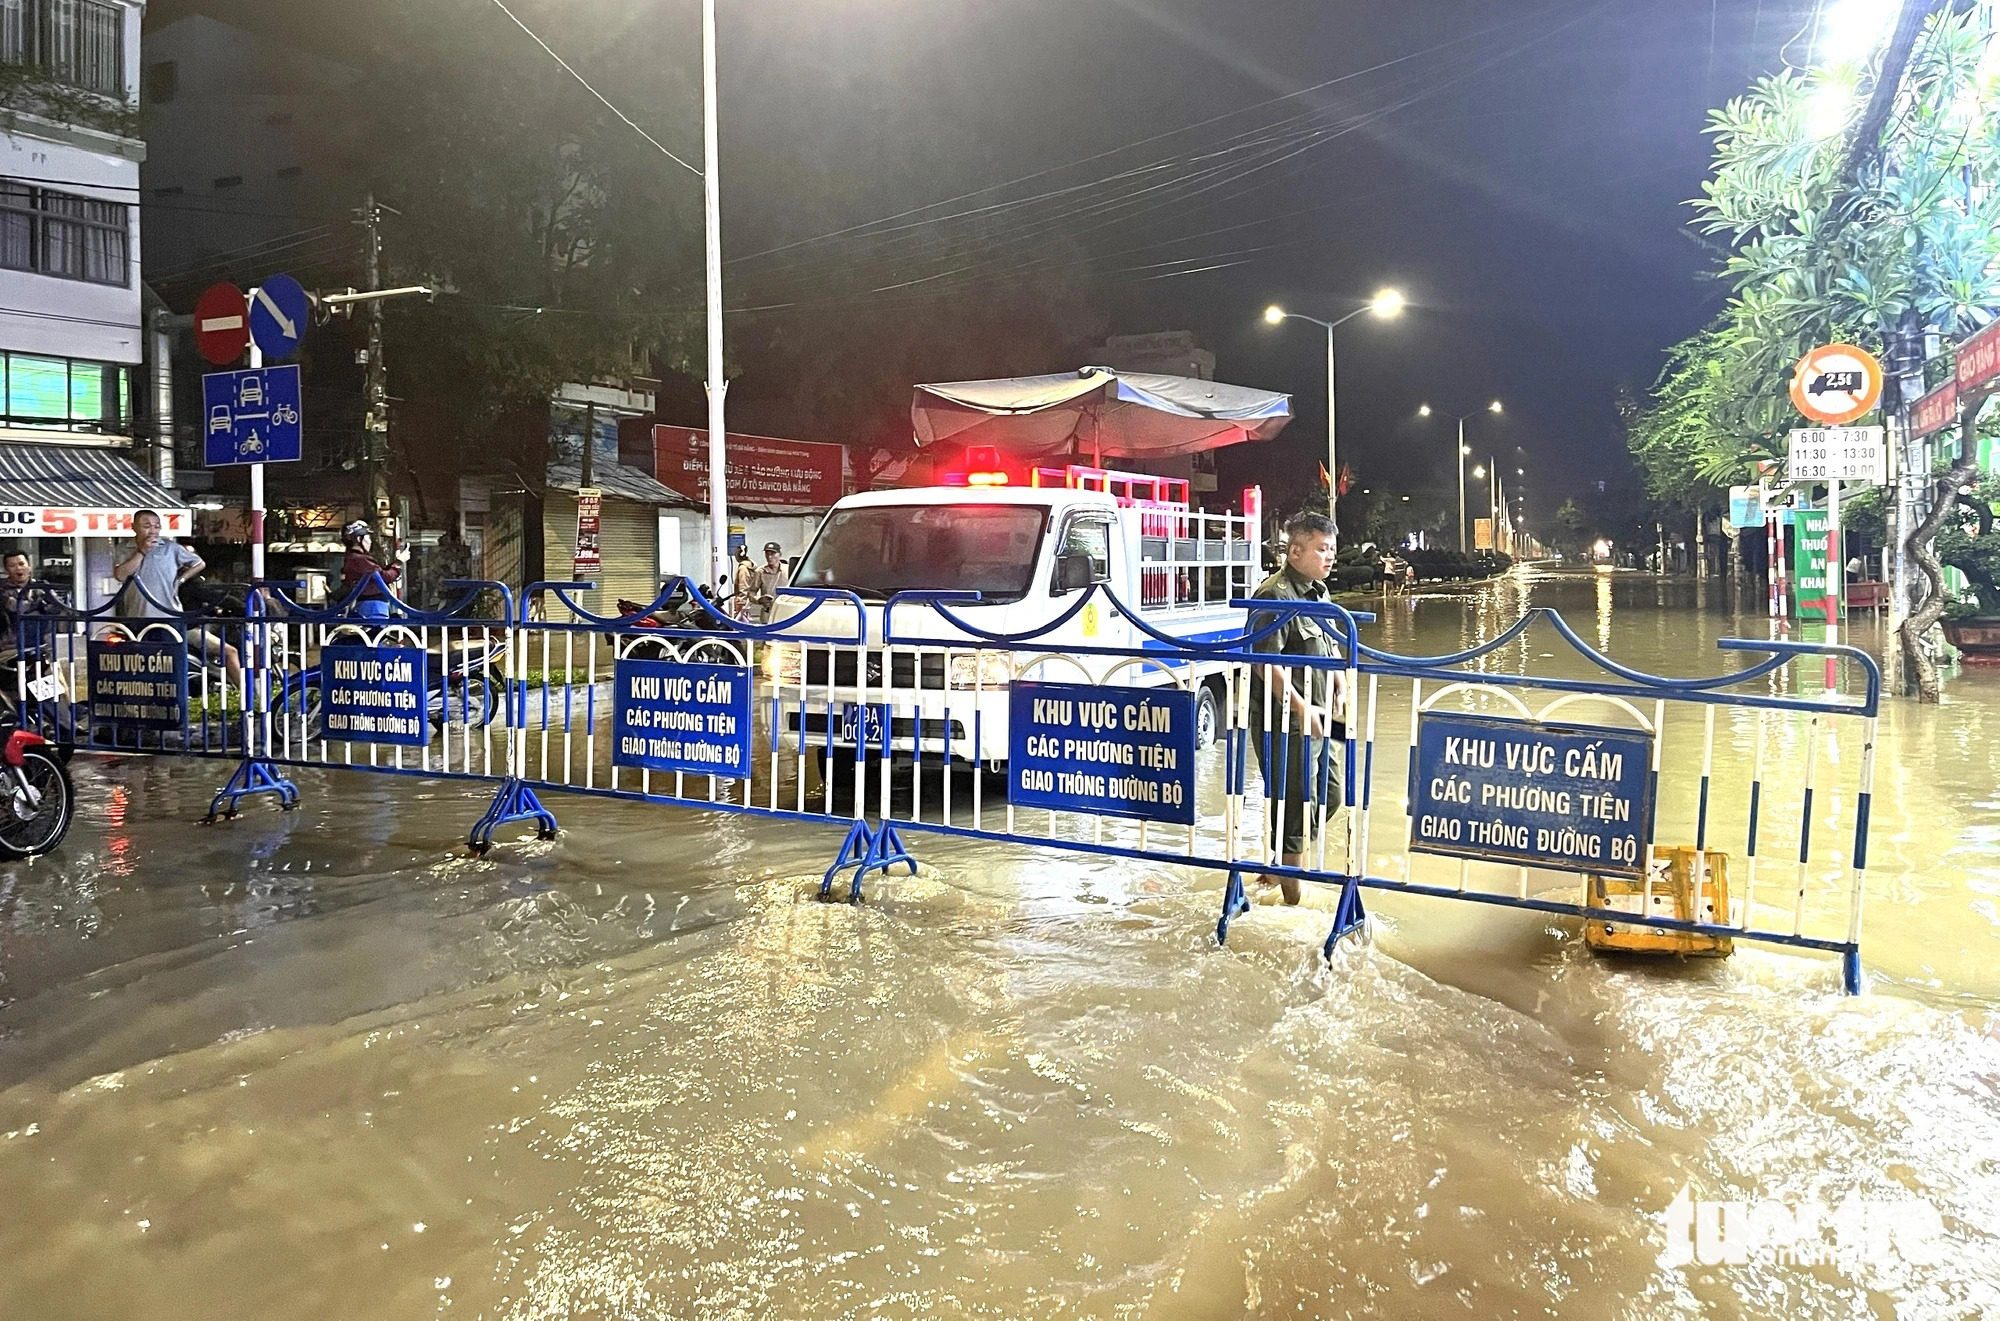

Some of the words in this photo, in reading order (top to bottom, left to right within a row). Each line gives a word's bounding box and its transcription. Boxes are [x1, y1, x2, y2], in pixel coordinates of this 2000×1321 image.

[1801, 432, 1825, 443] 6:00
[1843, 431, 1868, 441] 7:30
[1796, 449, 1826, 459] 11:30
[1843, 448, 1875, 458] 13:30
[1795, 466, 1826, 476] 16:30
[1843, 465, 1875, 475] 19:00
[41, 509, 77, 534] 5
[82, 513, 185, 531] THT
[1801, 535, 1828, 551] THUỐ
[1811, 558, 1826, 570] AN
[99, 654, 120, 671] KHU
[123, 652, 145, 675] VỰC
[148, 650, 173, 673] CẤM
[335, 661, 357, 679] KHU
[360, 660, 381, 684] VỰC
[385, 655, 412, 682] CẤM
[97, 678, 114, 695] CÁC
[116, 681, 153, 696] PHƯƠNG
[156, 681, 177, 699] TIỆN
[332, 687, 351, 704] CÁC
[353, 690, 391, 707] PHƯƠNG
[394, 690, 416, 710] TIỆN
[631, 677, 659, 699] KHU
[664, 677, 691, 705] VỰC
[696, 673, 731, 704] CẤM
[329, 714, 347, 729] GIAO
[350, 713, 375, 731] THÔNG
[377, 714, 406, 734] ĐƯỜNG
[408, 716, 419, 737] BỘ
[626, 706, 650, 727] CÁC
[654, 711, 703, 731] PHƯƠNG
[707, 713, 736, 736] TIỆN
[1034, 698, 1072, 726] KHU
[1078, 701, 1117, 733] VỰC
[1124, 698, 1170, 733] CẤM
[622, 737, 645, 755] GIAO
[649, 738, 681, 759] THÔNG
[725, 744, 739, 768] BỘ
[1027, 734, 1059, 758] CÁC
[1064, 739, 1133, 765] PHƯƠNG
[1139, 743, 1176, 771] TIỆN
[1445, 737, 1495, 768] KHU
[1506, 742, 1555, 777] VỰC
[1565, 741, 1622, 781] CẤM
[1021, 769, 1053, 791] GIAO
[1057, 771, 1104, 797] THÔNG
[1109, 774, 1157, 802] ĐƯỜNG
[1162, 780, 1183, 809] BỘ
[1431, 775, 1471, 803] CÁC
[1483, 784, 1570, 814] PHƯƠNG
[1580, 792, 1629, 824] TIỆN
[1421, 815, 1461, 840] GIAO
[1468, 819, 1528, 849] THÔNG
[1537, 826, 1600, 858] ĐƯỜNG
[1611, 834, 1636, 866] BỘ
